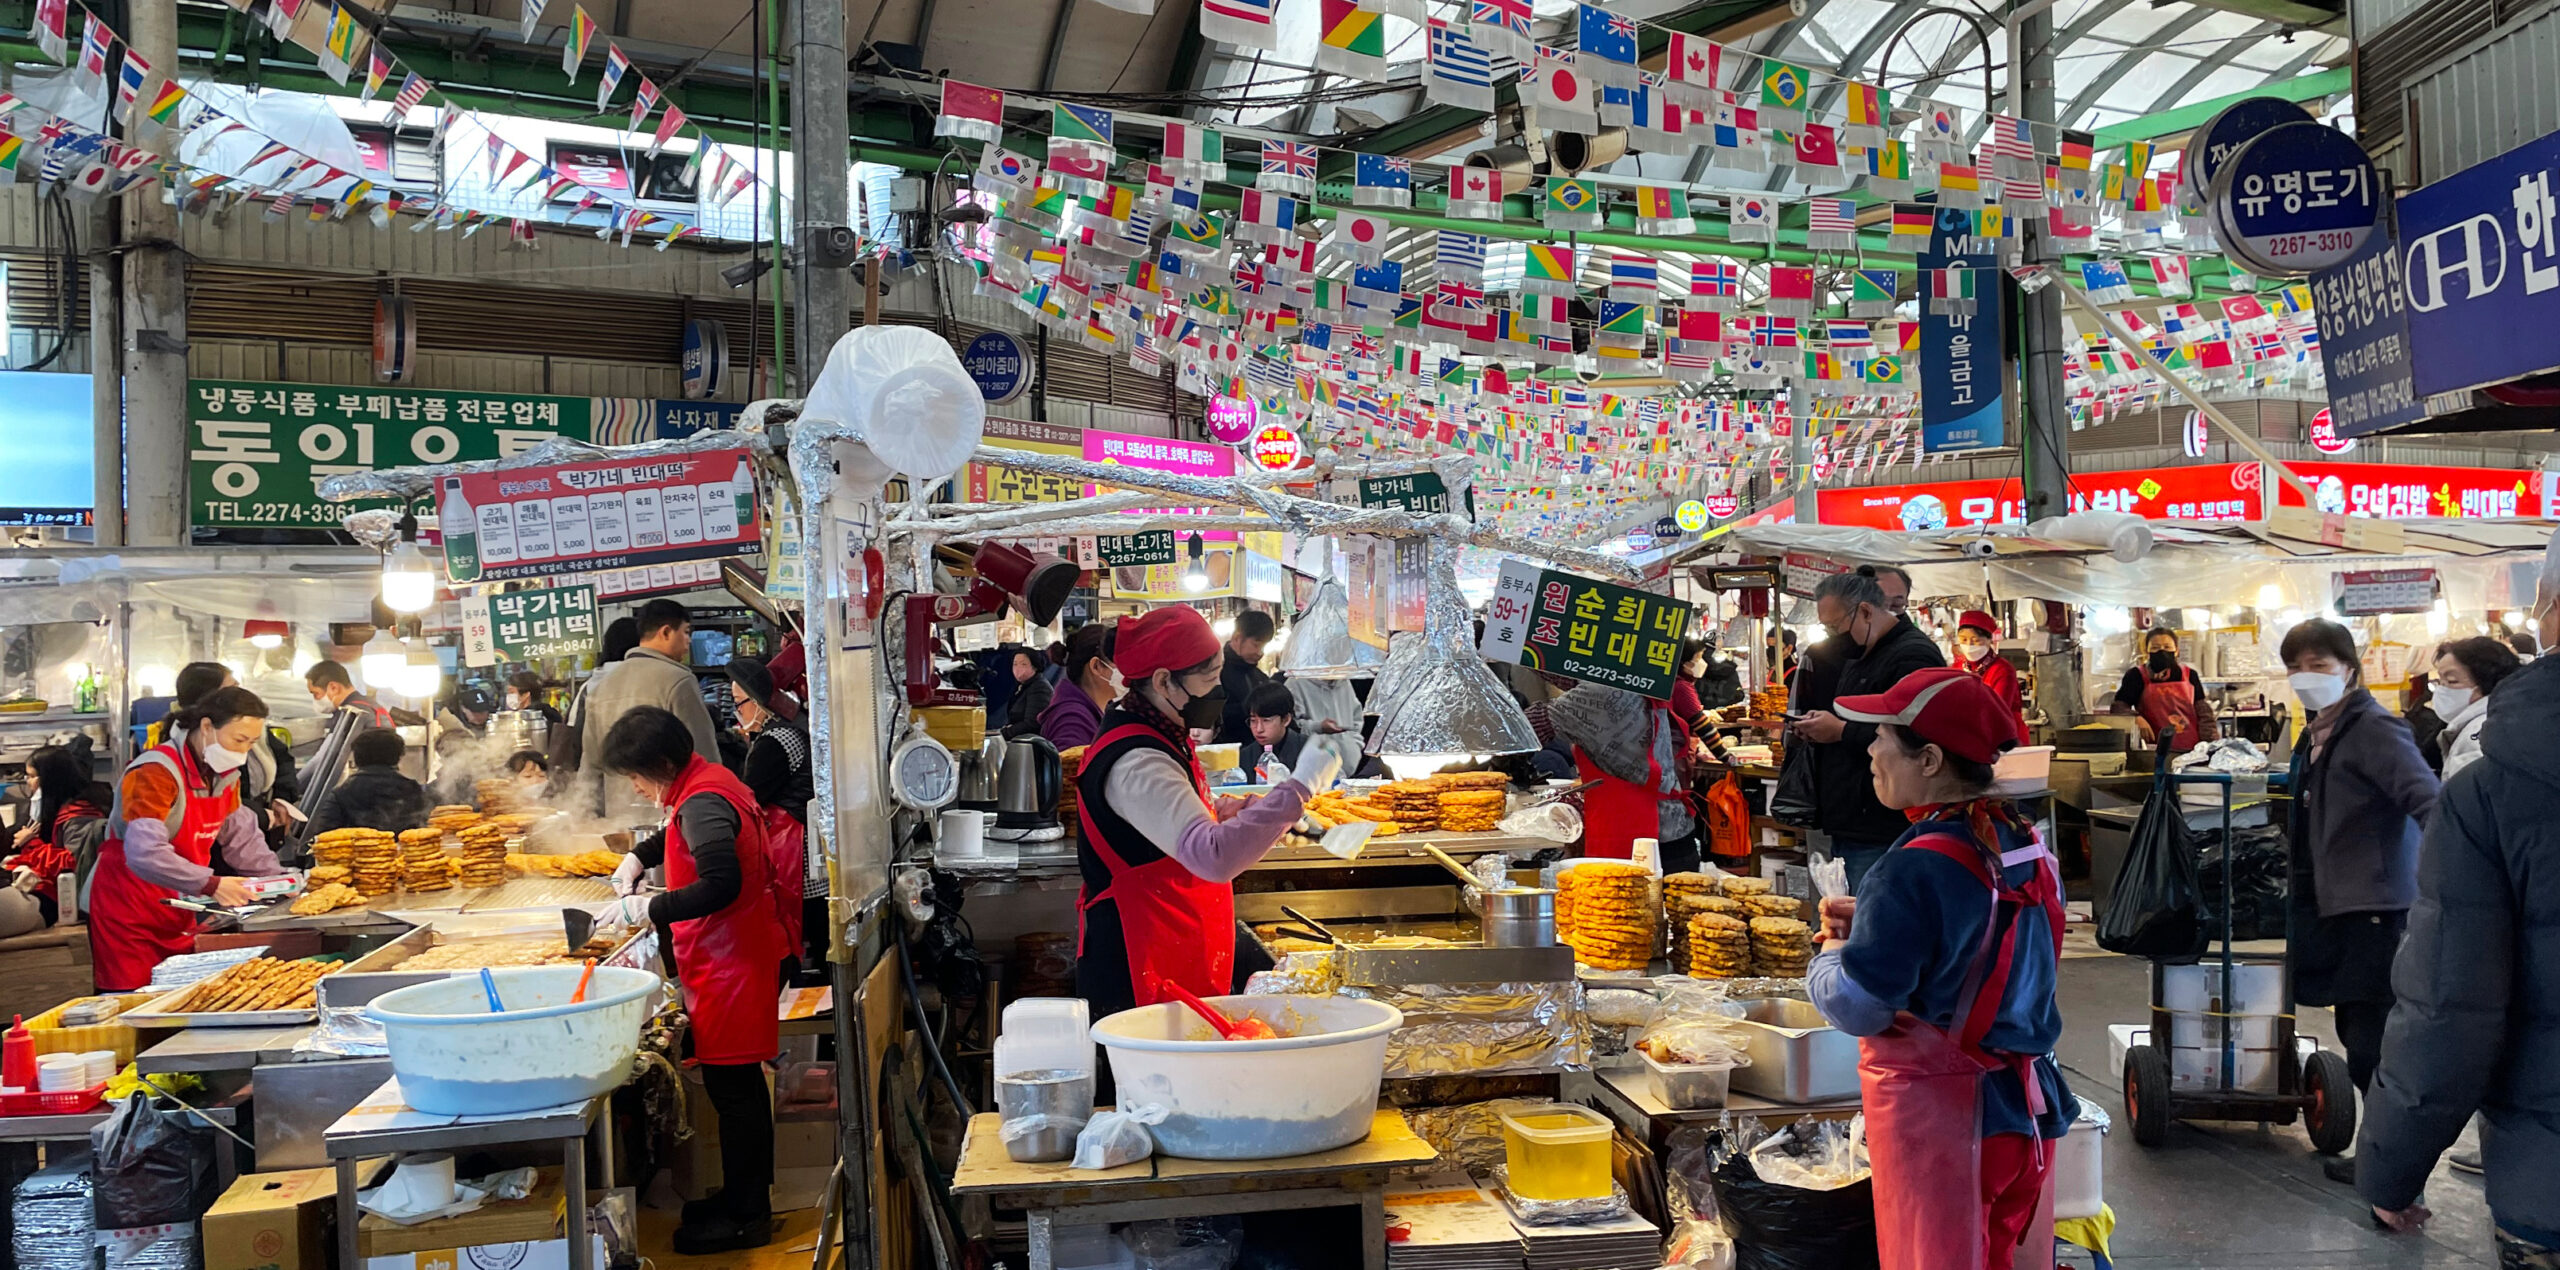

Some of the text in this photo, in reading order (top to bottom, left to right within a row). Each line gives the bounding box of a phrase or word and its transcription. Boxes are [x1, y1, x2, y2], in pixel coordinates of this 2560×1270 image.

[2238, 164, 2369, 218] 유명도기
[2269, 230, 2353, 257] 2267-3310
[2313, 245, 2405, 341] 장충낙원떡집
[965, 357, 1019, 376] 수원아줌마
[456, 400, 559, 427] 전문업체
[666, 409, 719, 430] 식자재
[1210, 411, 1252, 431] 일번지
[1262, 430, 1288, 441] 육회
[1255, 441, 1296, 454] 순대국밥
[1260, 453, 1291, 465] 빈대떡
[569, 462, 685, 489] 박가네 빈대떡
[1369, 477, 1414, 497] 박가네
[635, 496, 652, 506] 육회
[663, 492, 697, 505] 잔치국수
[708, 489, 725, 500] 순대
[590, 499, 624, 511] 고기완자
[1863, 496, 1901, 507] Since 1975
[486, 507, 503, 517] 고기
[557, 503, 583, 514] 빈대떡
[482, 515, 509, 526] 빈대떡
[674, 528, 696, 538] 5,000
[710, 524, 732, 534] 7,000
[563, 539, 585, 549] 5,000
[600, 536, 623, 546] 6,000
[1081, 540, 1093, 549] 58
[487, 546, 513, 557] 10,000
[524, 543, 550, 553] 10,000
[1109, 552, 1170, 564] 2267-0614
[520, 565, 537, 576] 대표
[1501, 576, 1535, 595] 동부A
[496, 588, 592, 618] 박가네
[464, 609, 488, 620] 동부A
[1494, 596, 1529, 625] 59-1
[1531, 581, 1570, 646] 원조
[1574, 587, 1686, 641] 순희네
[471, 625, 486, 637] 59
[500, 612, 595, 645] 빈대떡
[1497, 627, 1513, 644] 호
[523, 637, 595, 657] 2264-0847
[1568, 621, 1679, 676] 빈대떡
[1563, 658, 1656, 690] 02-2273-5057
